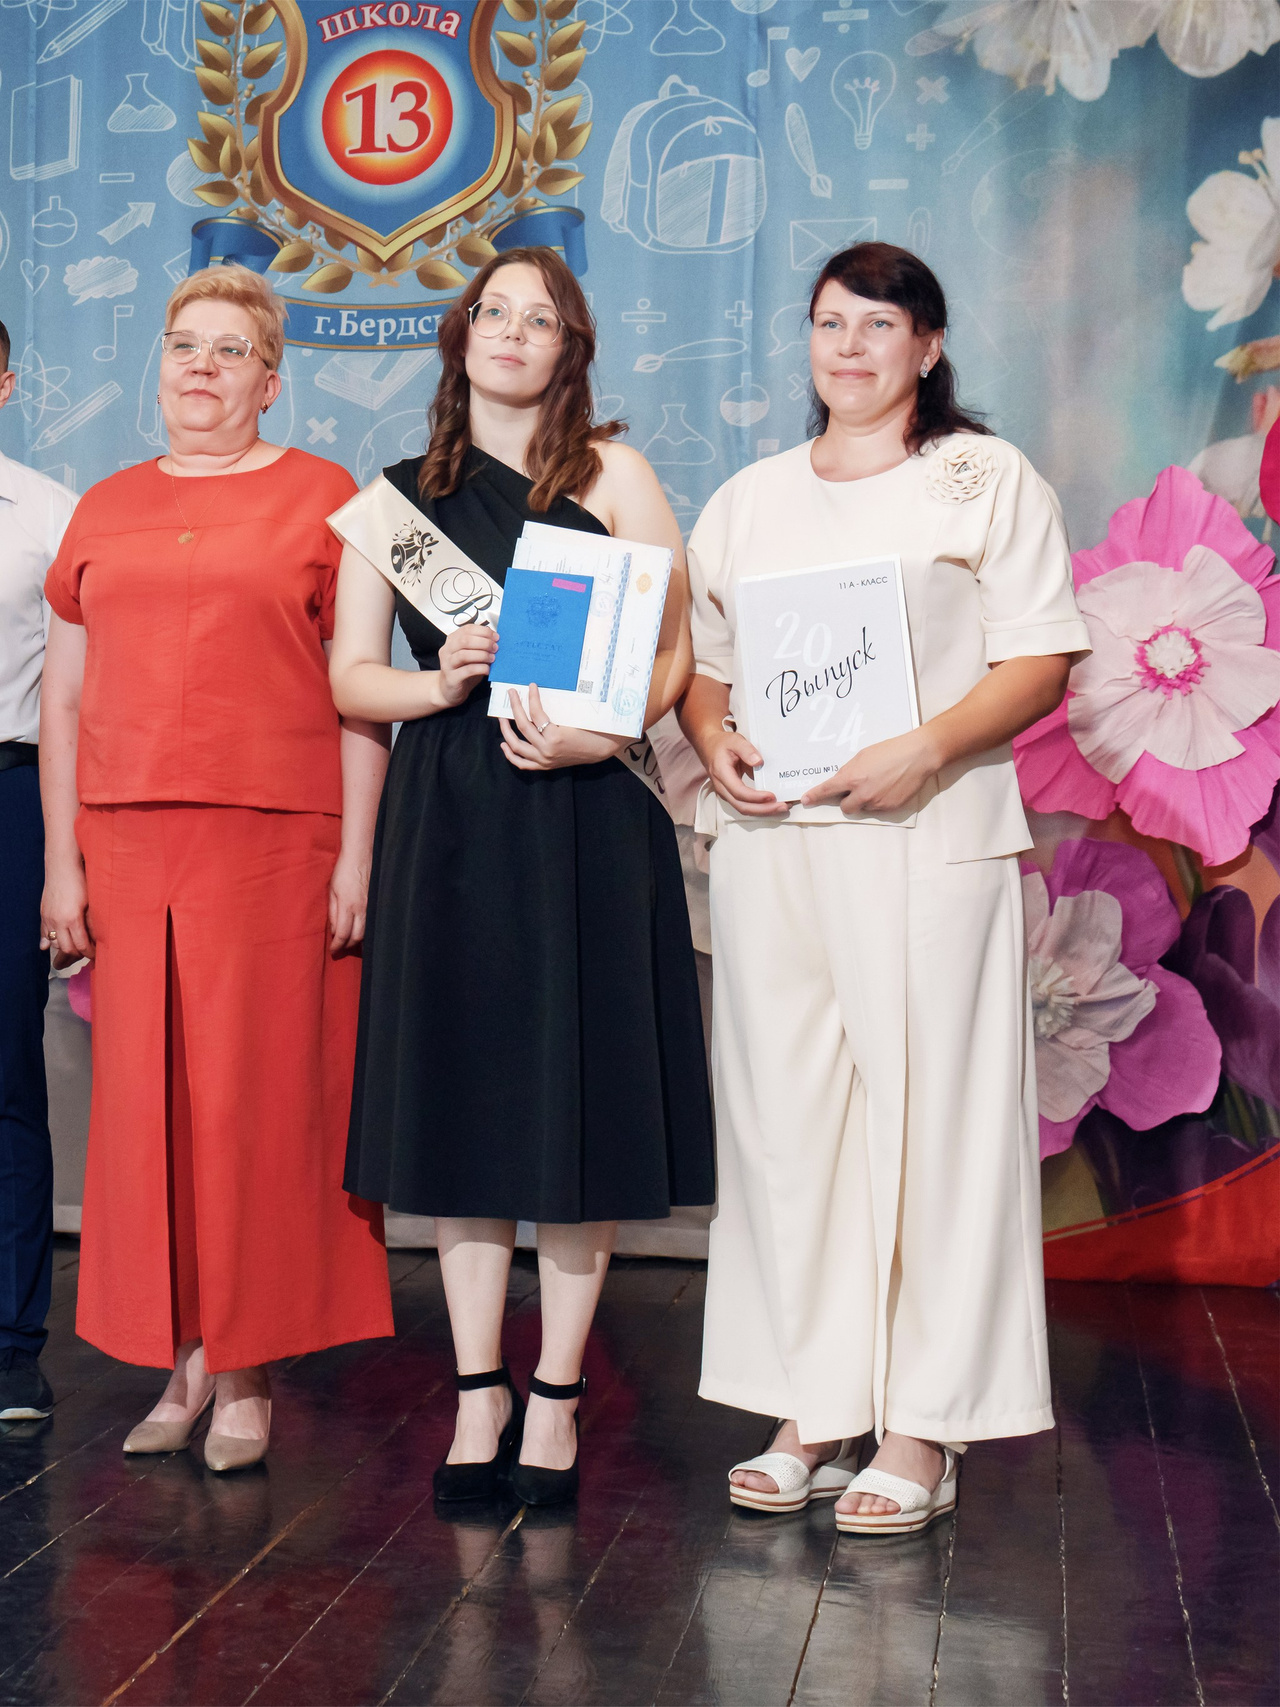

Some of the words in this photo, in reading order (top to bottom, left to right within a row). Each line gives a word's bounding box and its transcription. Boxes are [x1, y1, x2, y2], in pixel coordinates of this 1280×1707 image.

[344, 80, 432, 156] 13
[839, 582, 846, 590] 11
[861, 576, 888, 587] КЛАСС
[773, 611, 832, 667] 20
[765, 626, 876, 717] Выпуск
[807, 694, 866, 752] 24
[778, 769, 801, 779] МБОУ
[802, 767, 822, 776] СОШ
